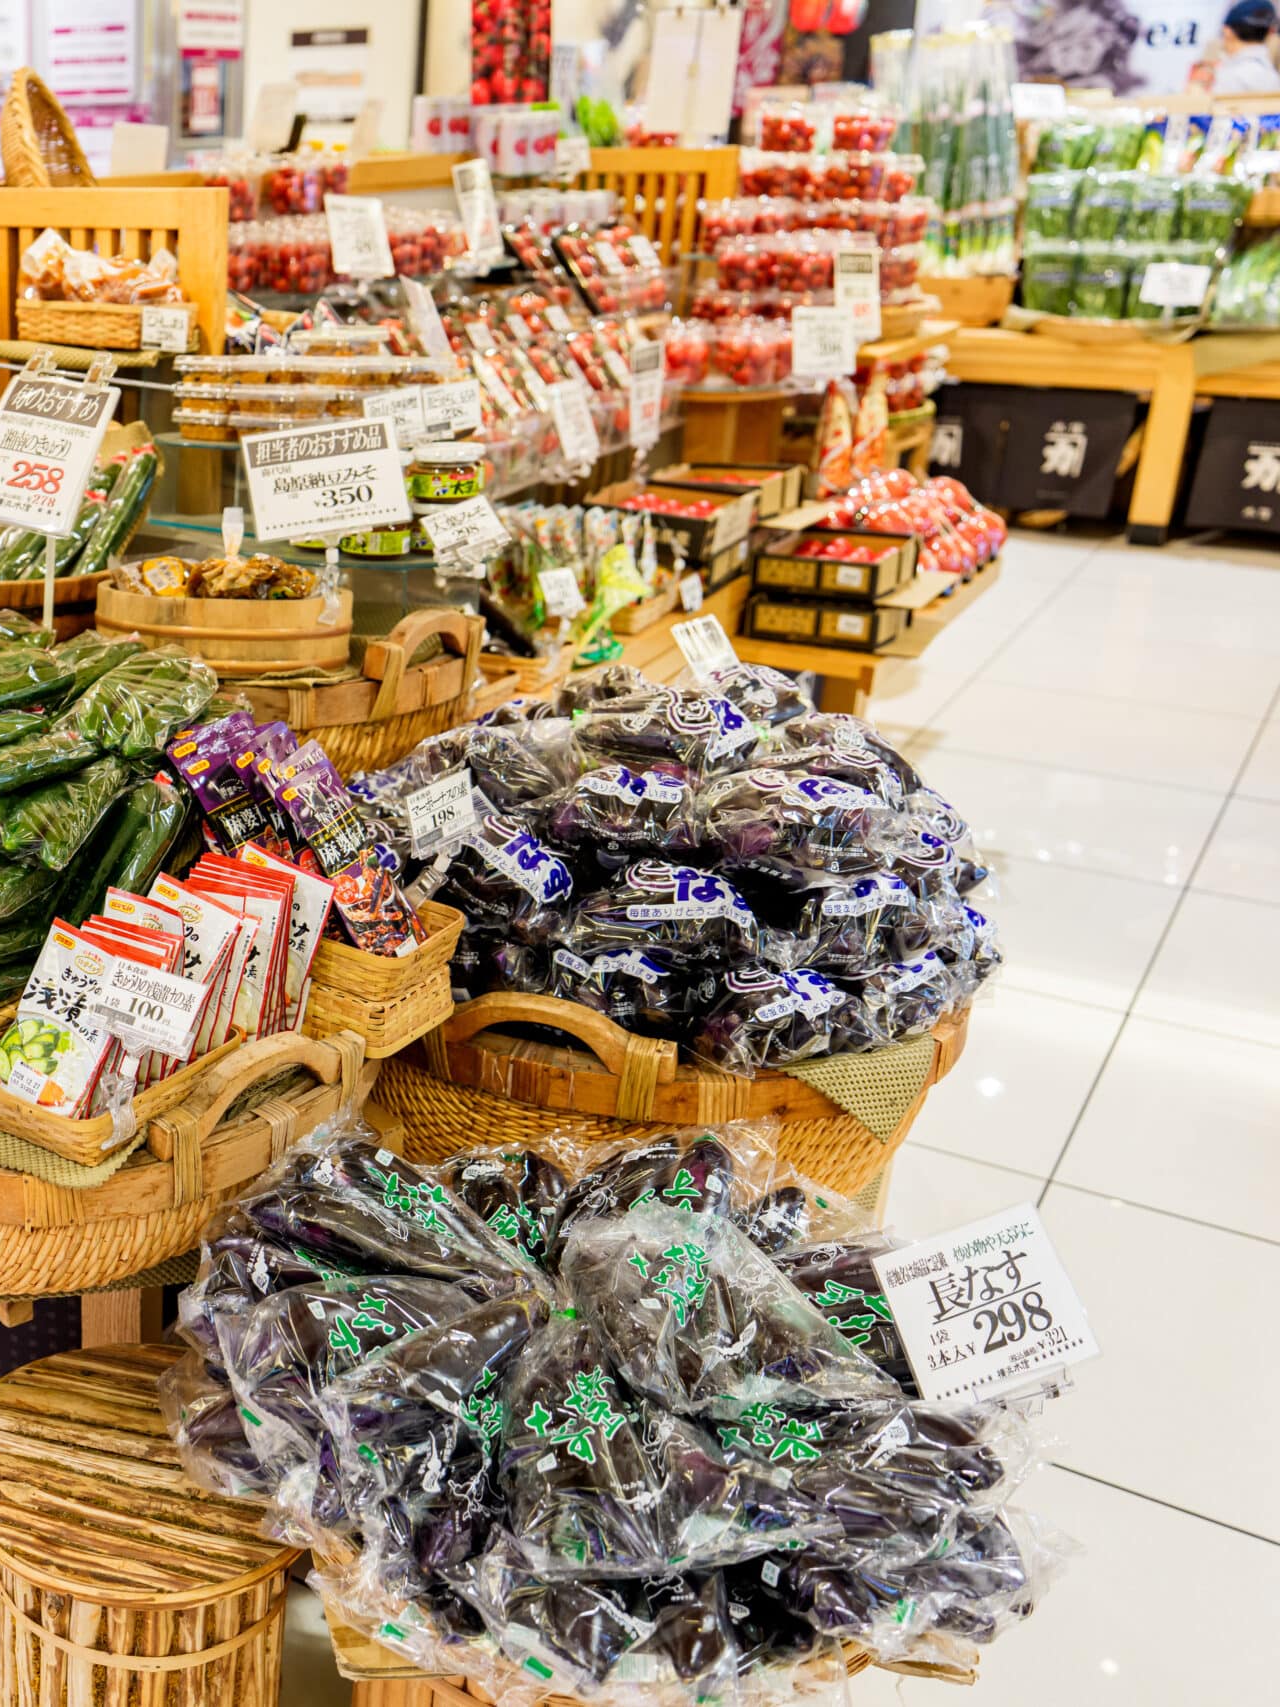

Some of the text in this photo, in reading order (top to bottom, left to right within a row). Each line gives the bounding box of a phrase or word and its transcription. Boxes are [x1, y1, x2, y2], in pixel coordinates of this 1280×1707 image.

[255, 424, 382, 466] 担当者のおすすめ品
[410, 780, 469, 817] マーボーナスの素
[927, 1249, 1028, 1322] 長なす
